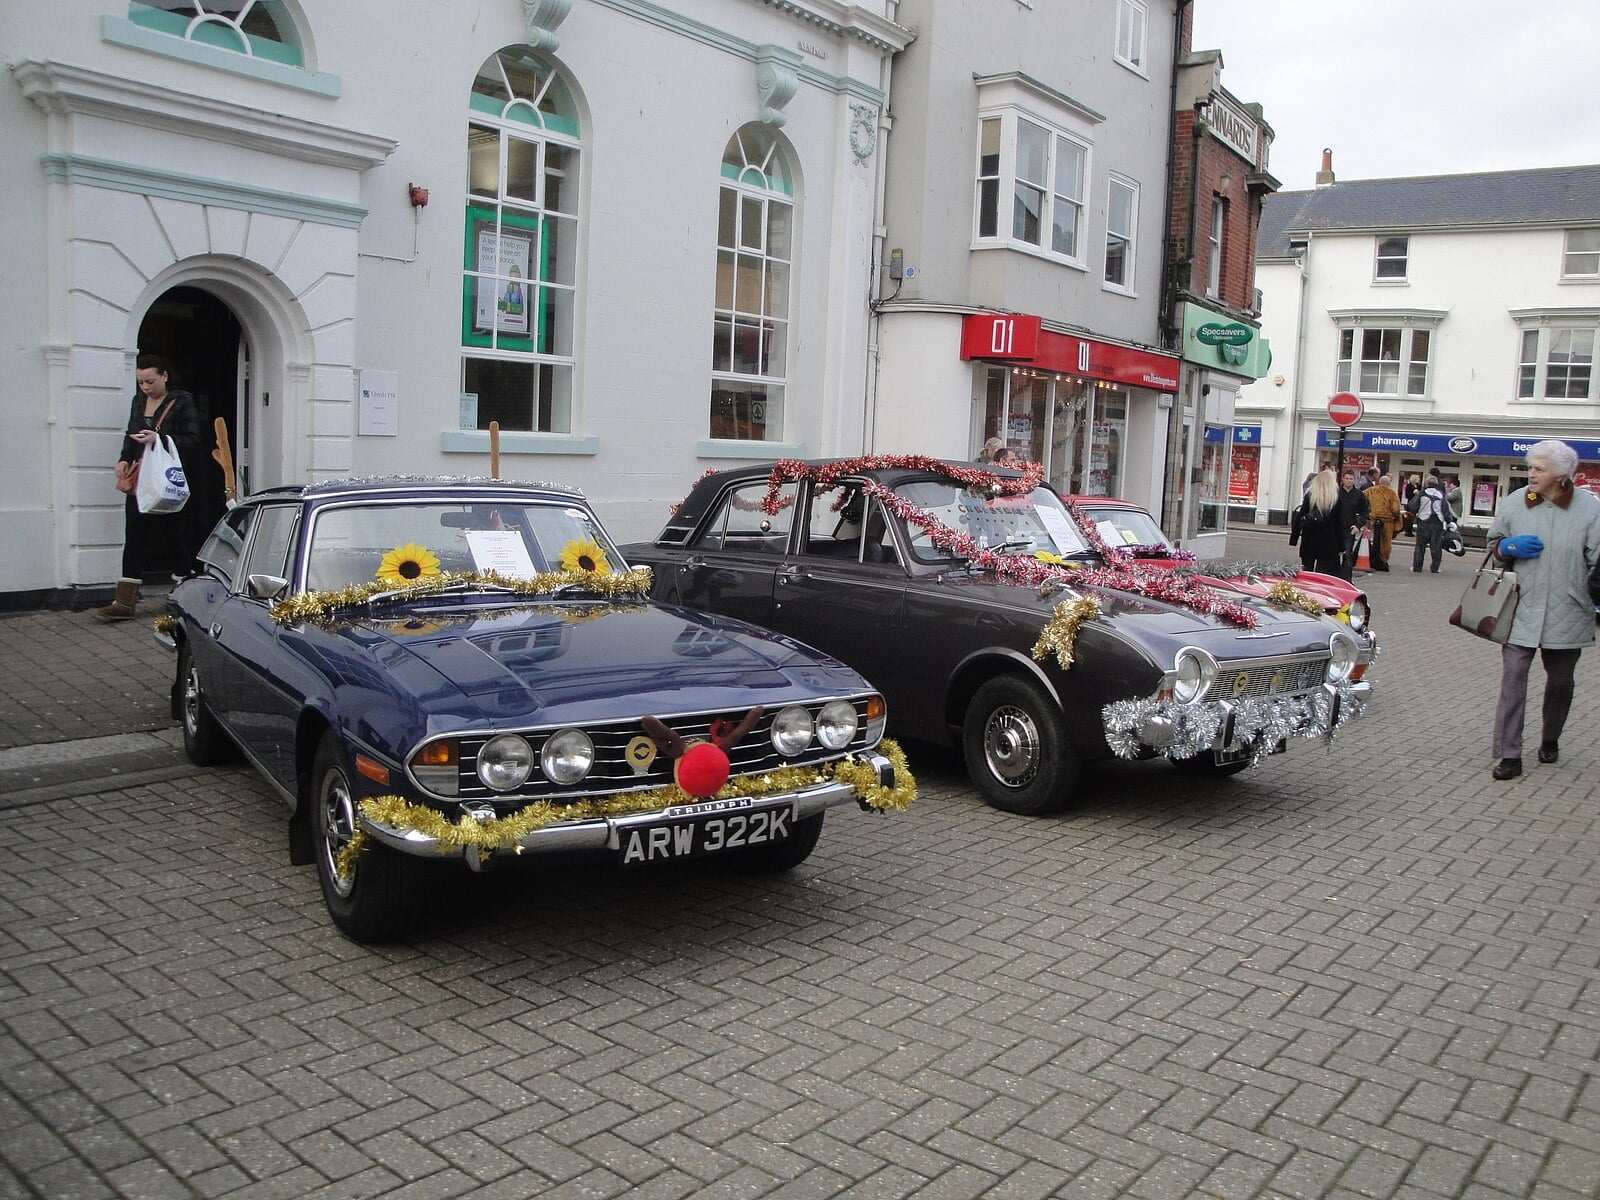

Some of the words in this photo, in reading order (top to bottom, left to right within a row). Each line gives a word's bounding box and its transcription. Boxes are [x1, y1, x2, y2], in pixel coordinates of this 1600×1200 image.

[1200, 101, 1251, 153] ENNARDS
[1201, 327, 1246, 337] Specsavers
[1371, 435, 1418, 448] pharmacy
[1512, 441, 1532, 452] bea
[1343, 455, 1350, 464] 3
[1358, 455, 1365, 465] 2
[674, 800, 748, 815] TRIUMPH
[624, 823, 695, 864] ARW
[703, 807, 790, 852] 322K
